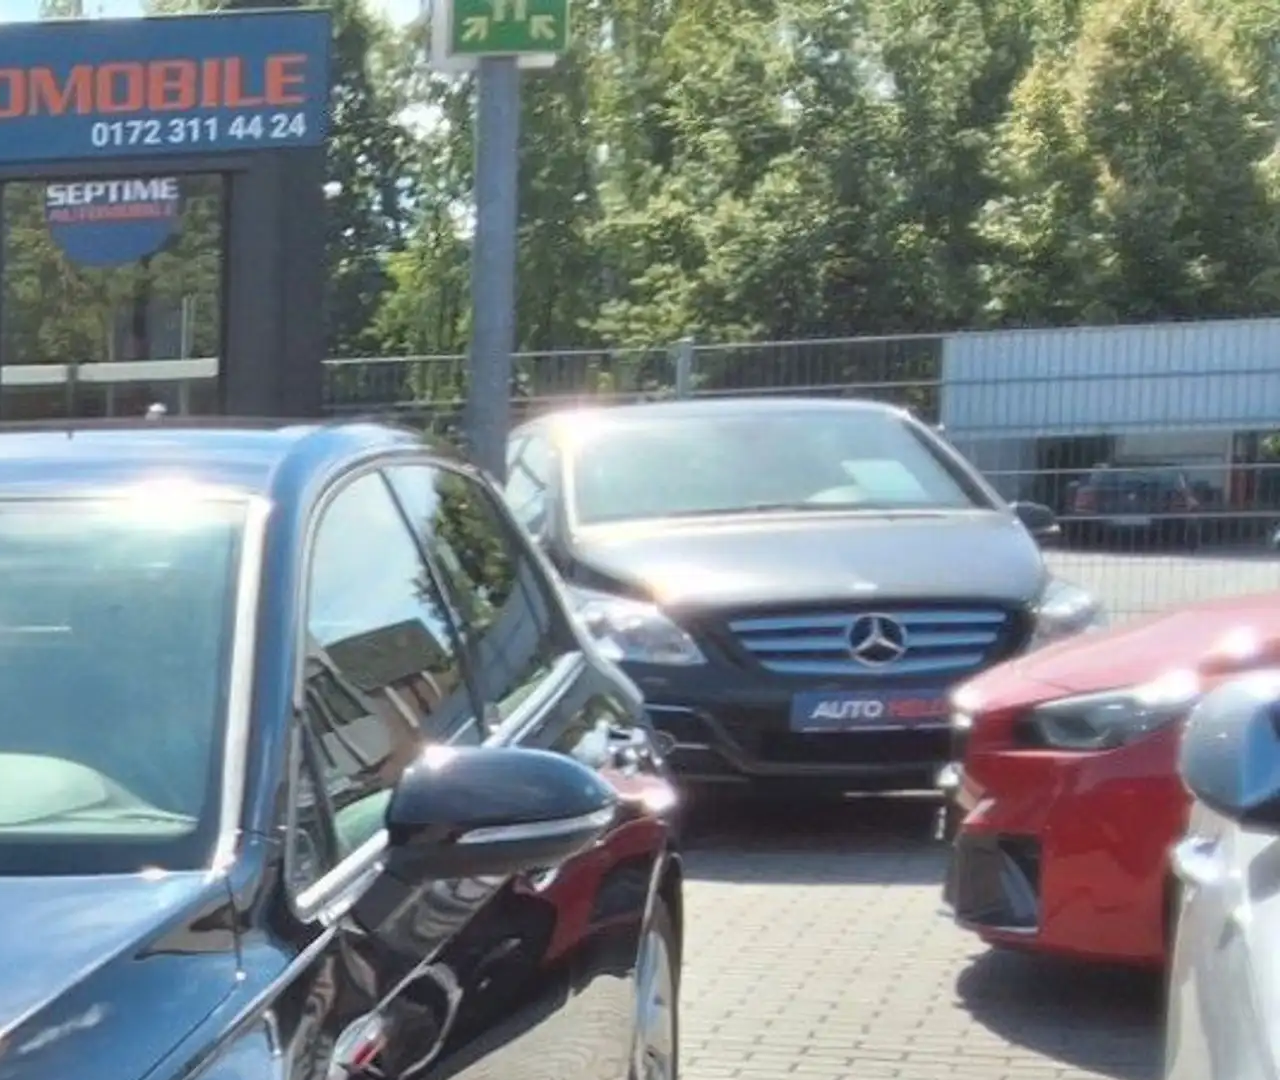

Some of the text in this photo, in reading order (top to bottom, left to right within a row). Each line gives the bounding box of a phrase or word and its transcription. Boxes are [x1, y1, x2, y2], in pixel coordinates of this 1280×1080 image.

[91, 112, 307, 147] 0172 311 44 24
[46, 177, 179, 207] SEPTIME
[809, 699, 884, 719] AUTO
